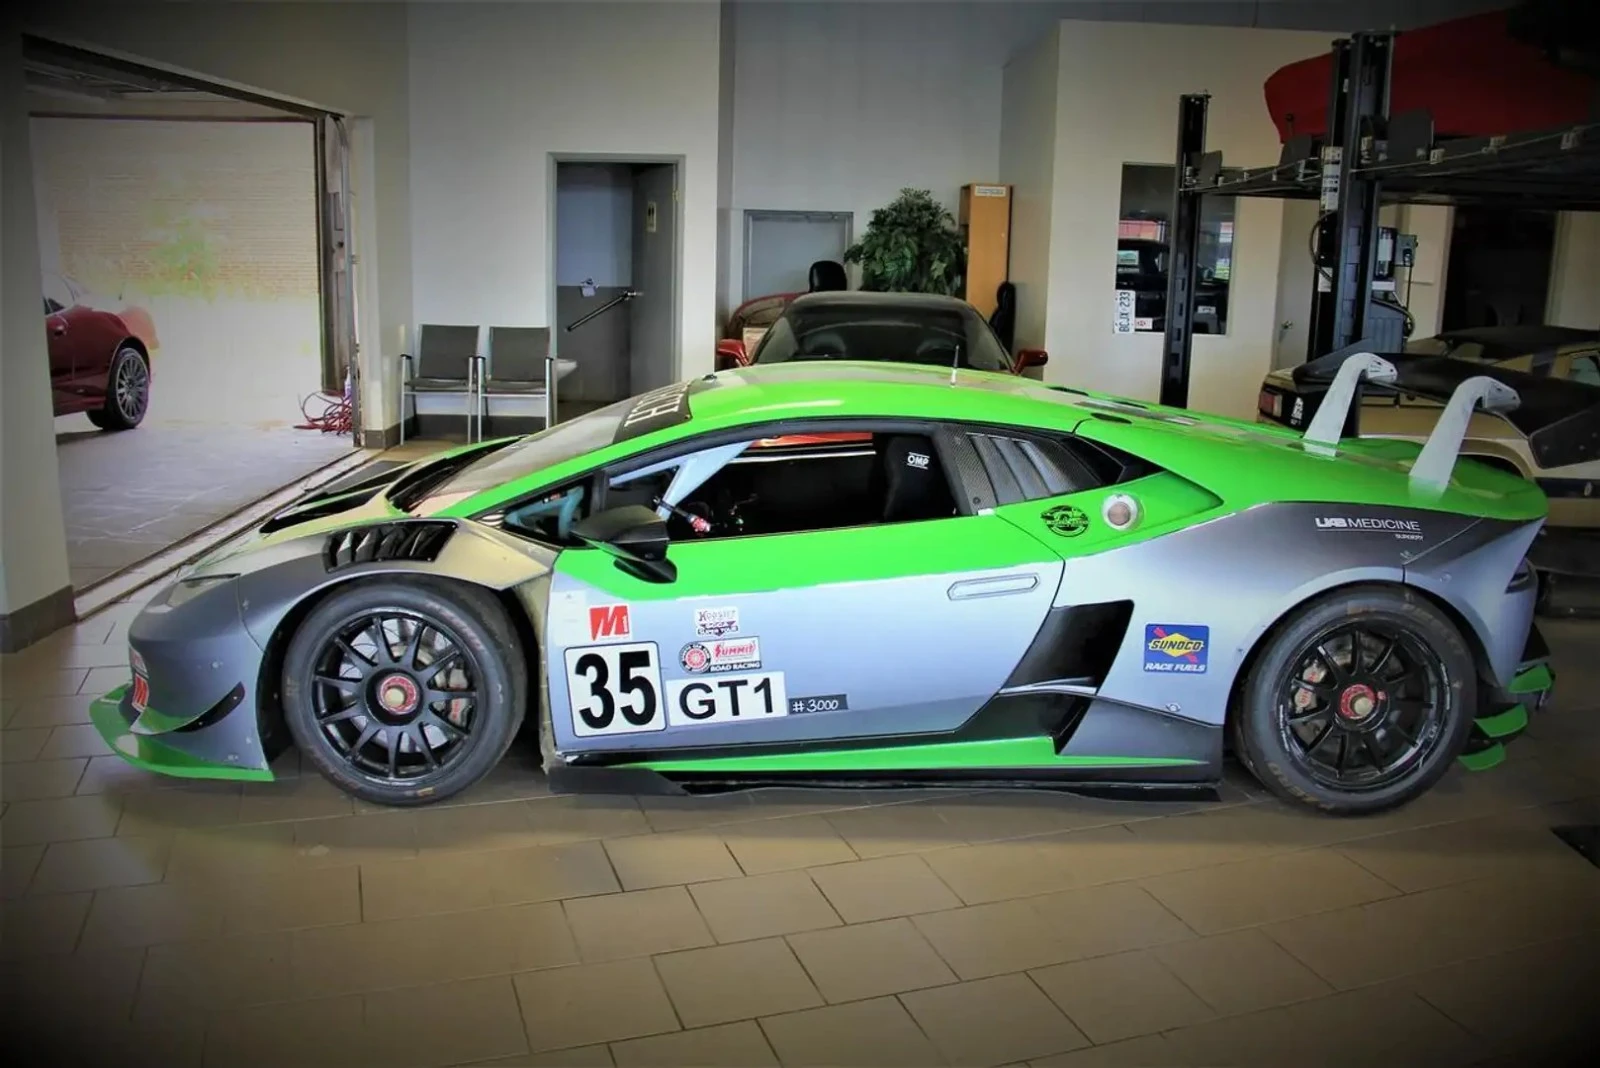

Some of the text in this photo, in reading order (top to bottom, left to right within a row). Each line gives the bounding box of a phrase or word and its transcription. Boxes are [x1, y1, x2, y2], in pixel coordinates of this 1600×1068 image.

[1119, 291, 1131, 308] 233
[907, 455, 929, 467] OMP
[1315, 517, 1421, 531] UAB MEDICINE
[714, 641, 757, 659] SUMMIT
[1150, 640, 1202, 651] SUNOCO
[710, 662, 760, 672] ROAD RACING
[1145, 662, 1206, 672] RACE FUELS
[575, 650, 657, 729] 35
[679, 677, 773, 720] GT1
